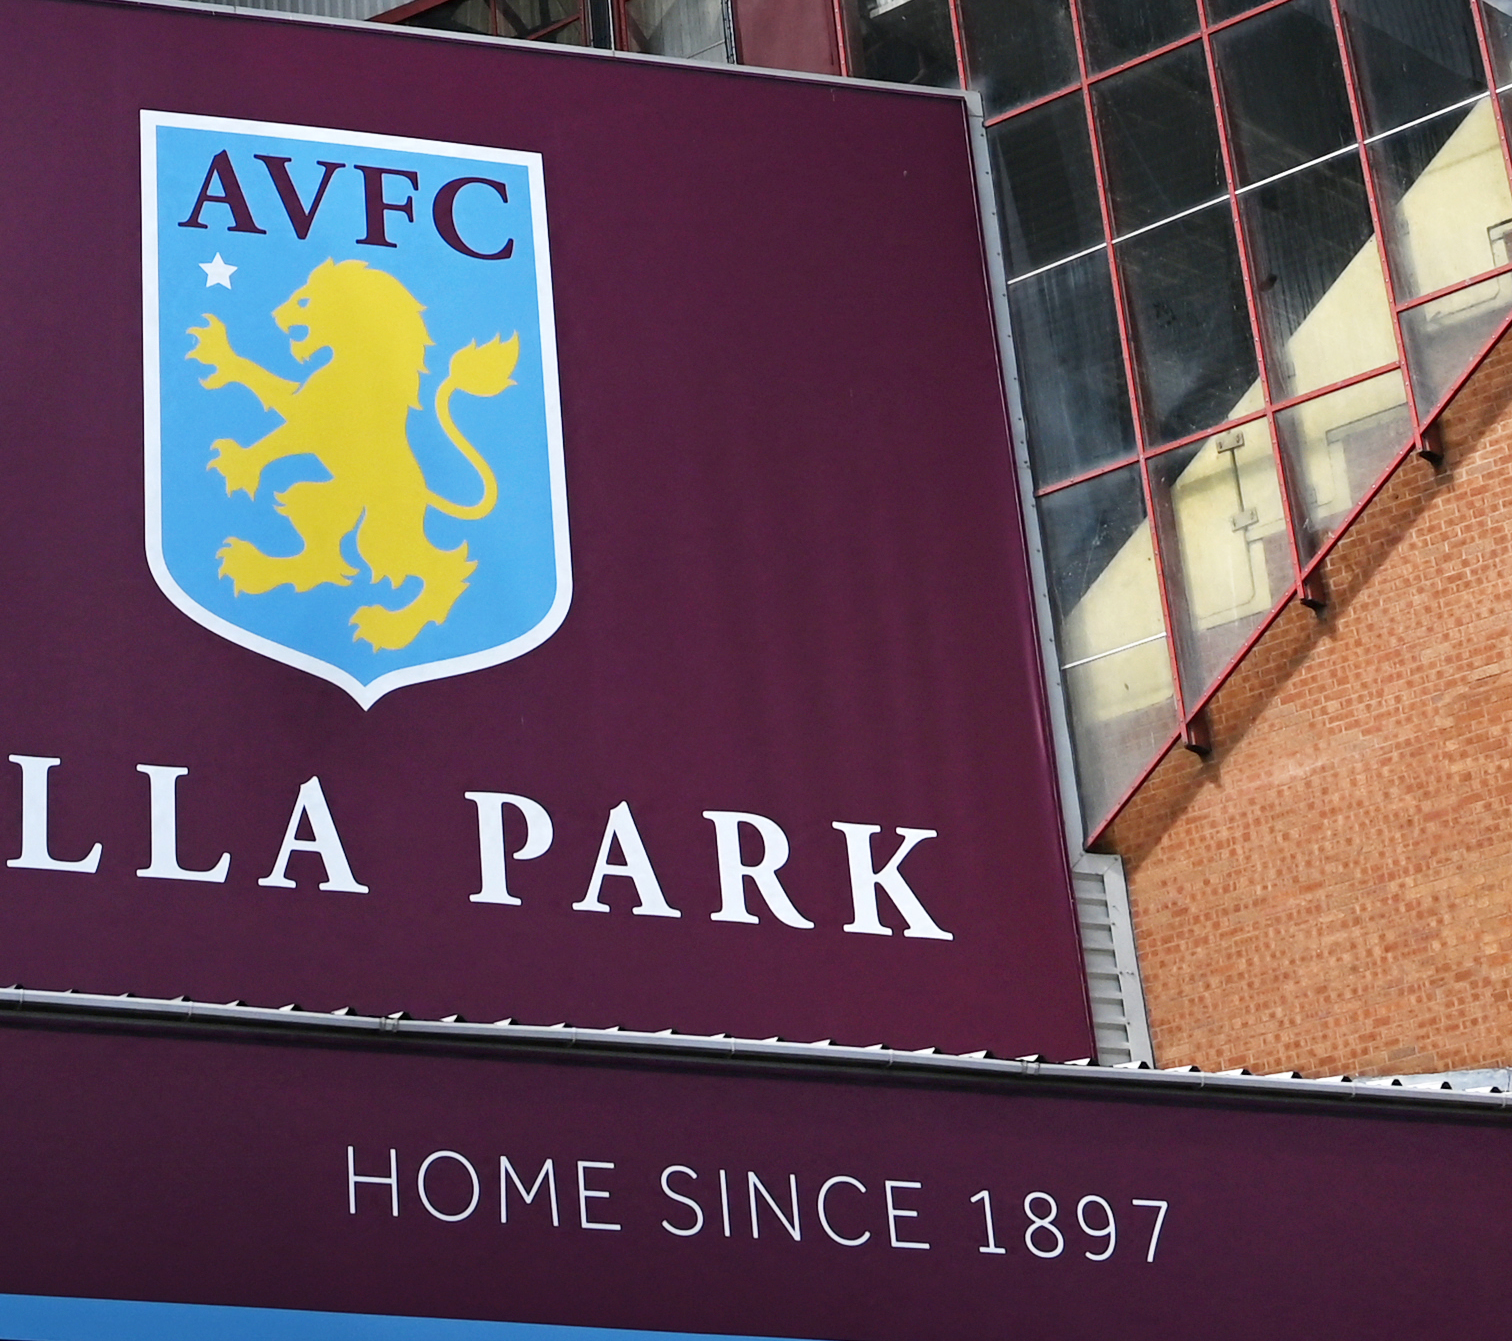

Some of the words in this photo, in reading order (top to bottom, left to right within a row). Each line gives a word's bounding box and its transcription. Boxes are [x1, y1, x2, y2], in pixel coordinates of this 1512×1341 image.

[177, 149, 514, 259] AVFC
[464, 791, 954, 941] PARK
[347, 1145, 622, 1231] HOME
[660, 1164, 930, 1250] SINCE
[970, 1189, 1169, 1263] 1897
